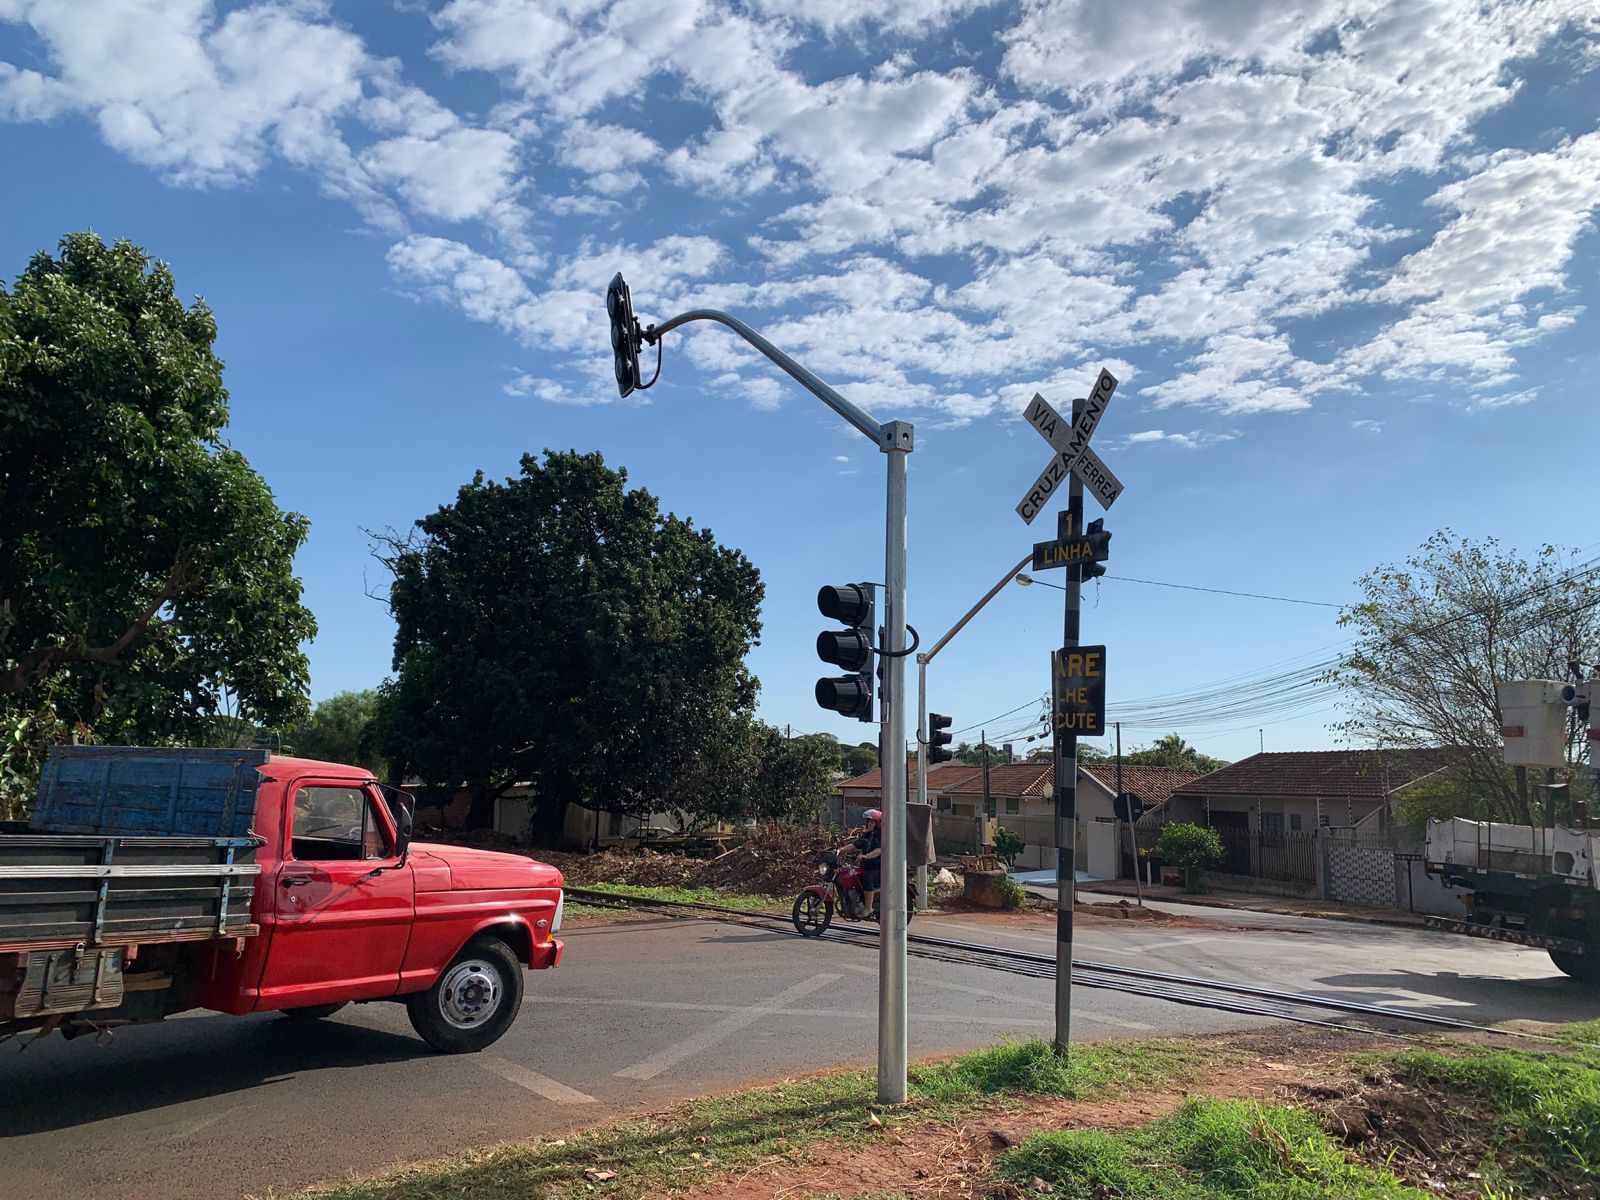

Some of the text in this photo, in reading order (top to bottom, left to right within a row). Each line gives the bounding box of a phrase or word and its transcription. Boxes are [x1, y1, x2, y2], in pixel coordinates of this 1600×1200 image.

[1032, 403, 1057, 438] VIA
[1022, 375, 1113, 519] CRUZAMENTO
[1065, 513, 1073, 537] 1
[1043, 541, 1093, 563] LINHA
[1056, 712, 1097, 729] CUTE
